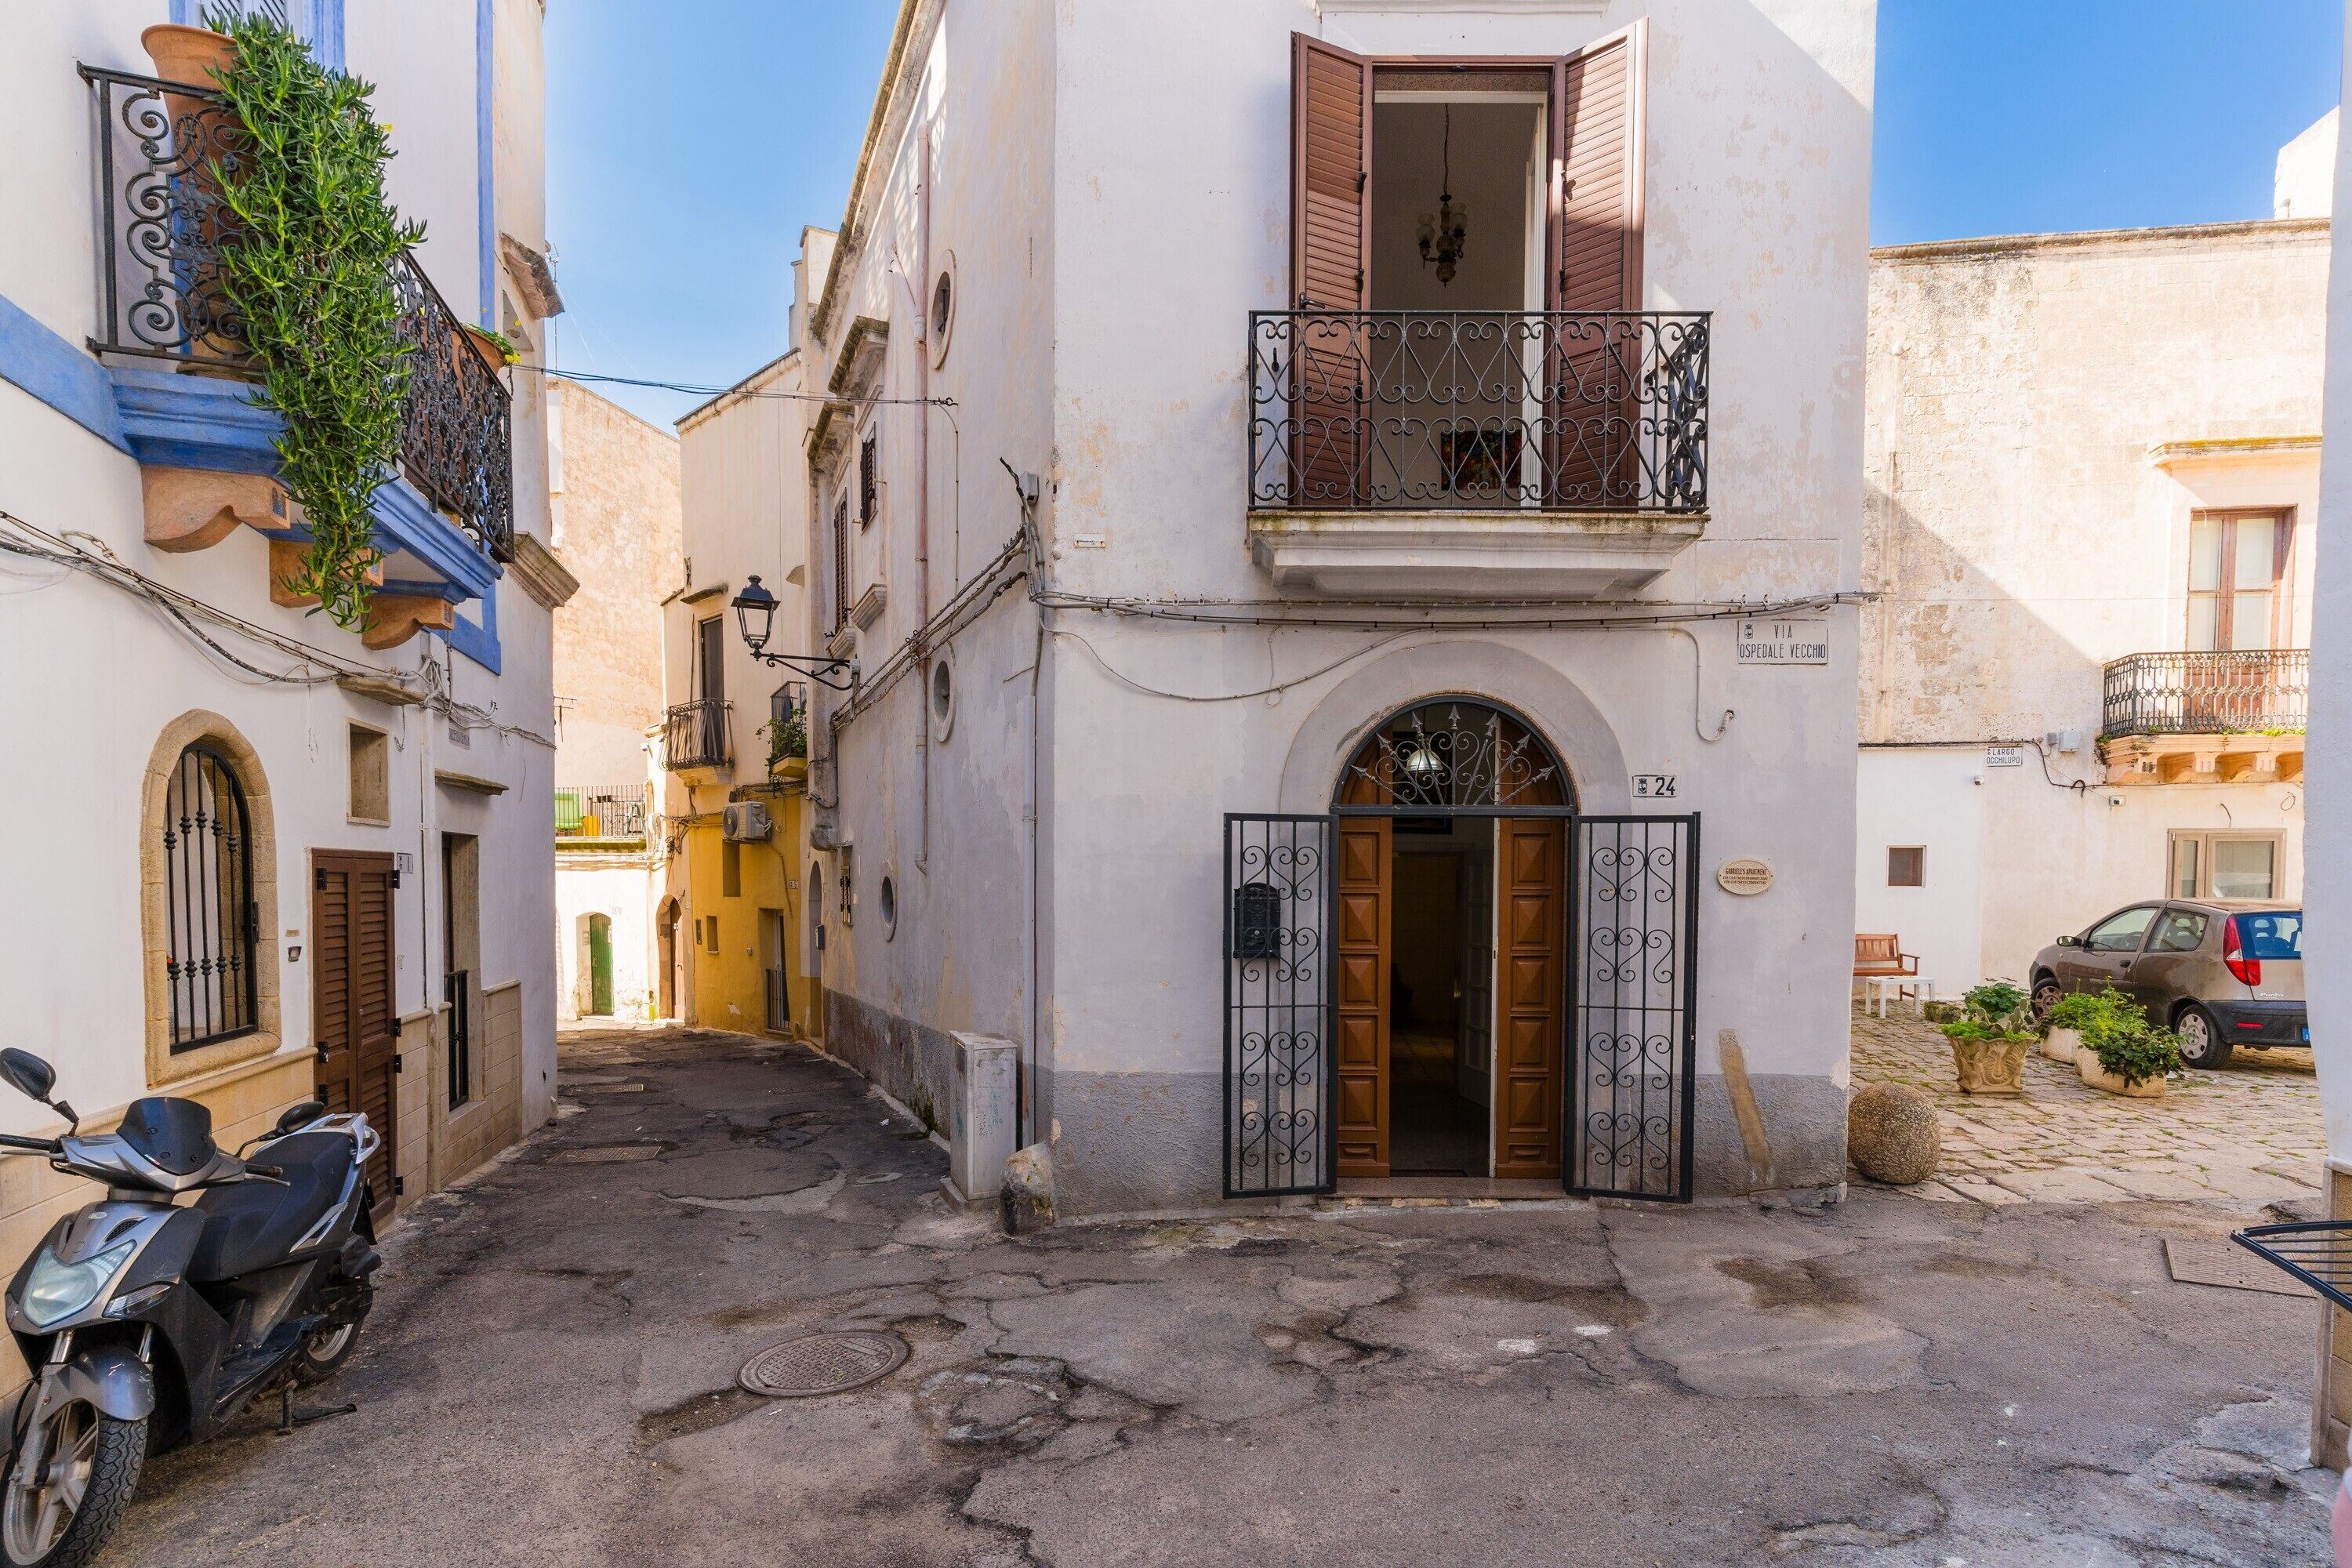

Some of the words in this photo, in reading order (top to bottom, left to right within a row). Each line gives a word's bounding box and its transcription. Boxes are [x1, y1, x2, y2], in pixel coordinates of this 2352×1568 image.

[1774, 624, 1792, 639] VIA
[1740, 644, 1784, 658] OSPEDALE
[1791, 644, 1826, 658] VECCHIO
[1655, 777, 1675, 795] 24
